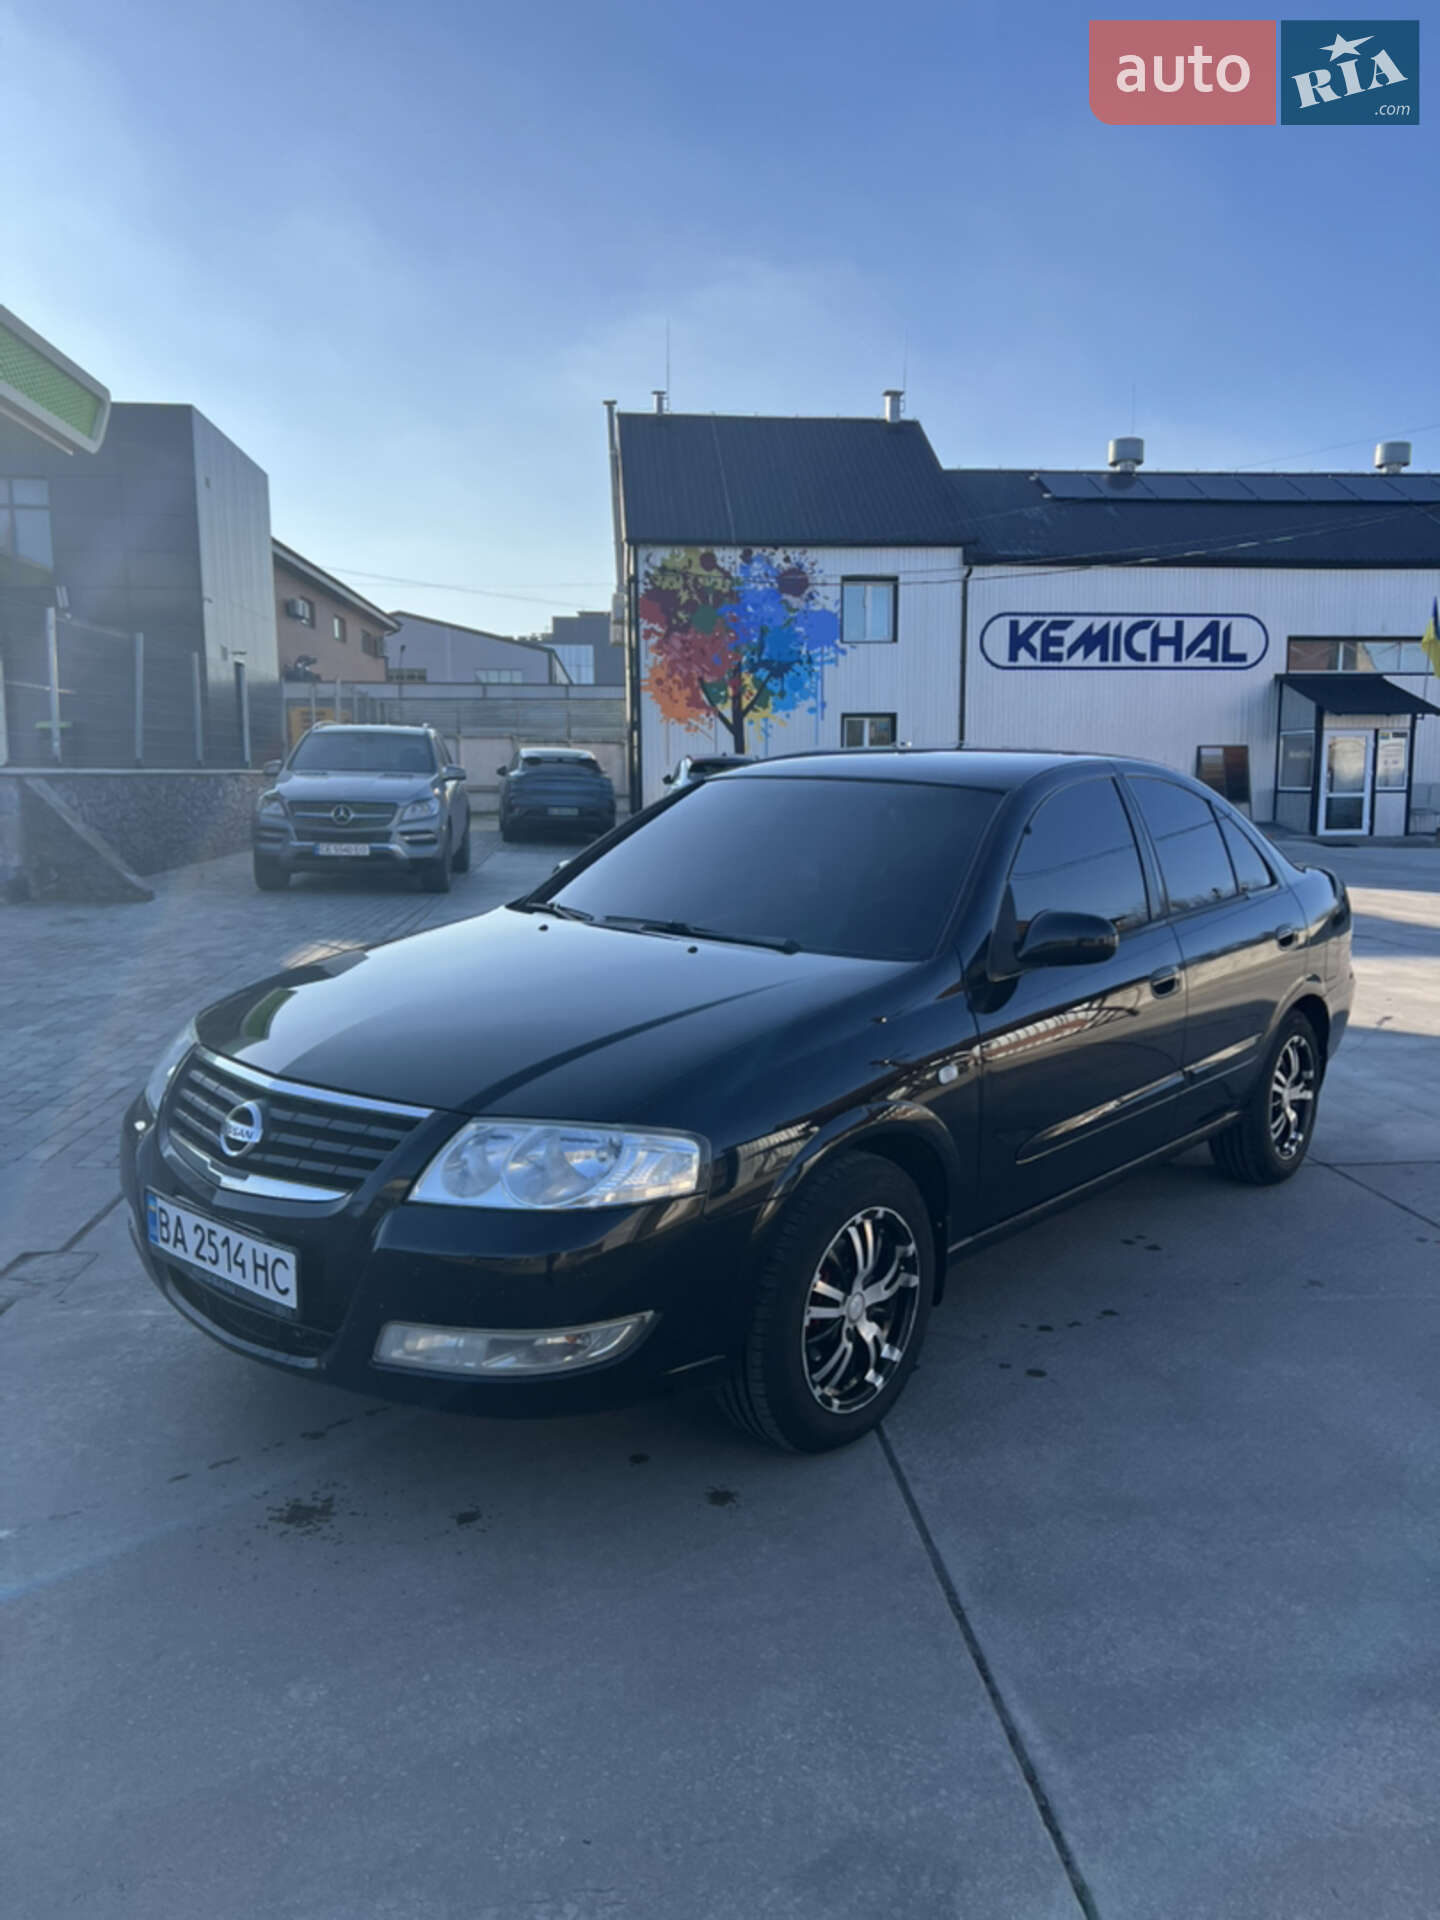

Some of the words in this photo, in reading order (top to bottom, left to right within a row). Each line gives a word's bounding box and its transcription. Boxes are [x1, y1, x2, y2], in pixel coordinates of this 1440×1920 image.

[1008, 619, 1247, 663] KEMICHAL
[159, 1207, 188, 1254] BA
[193, 1224, 246, 1279] 2514
[252, 1248, 289, 1295] HC
